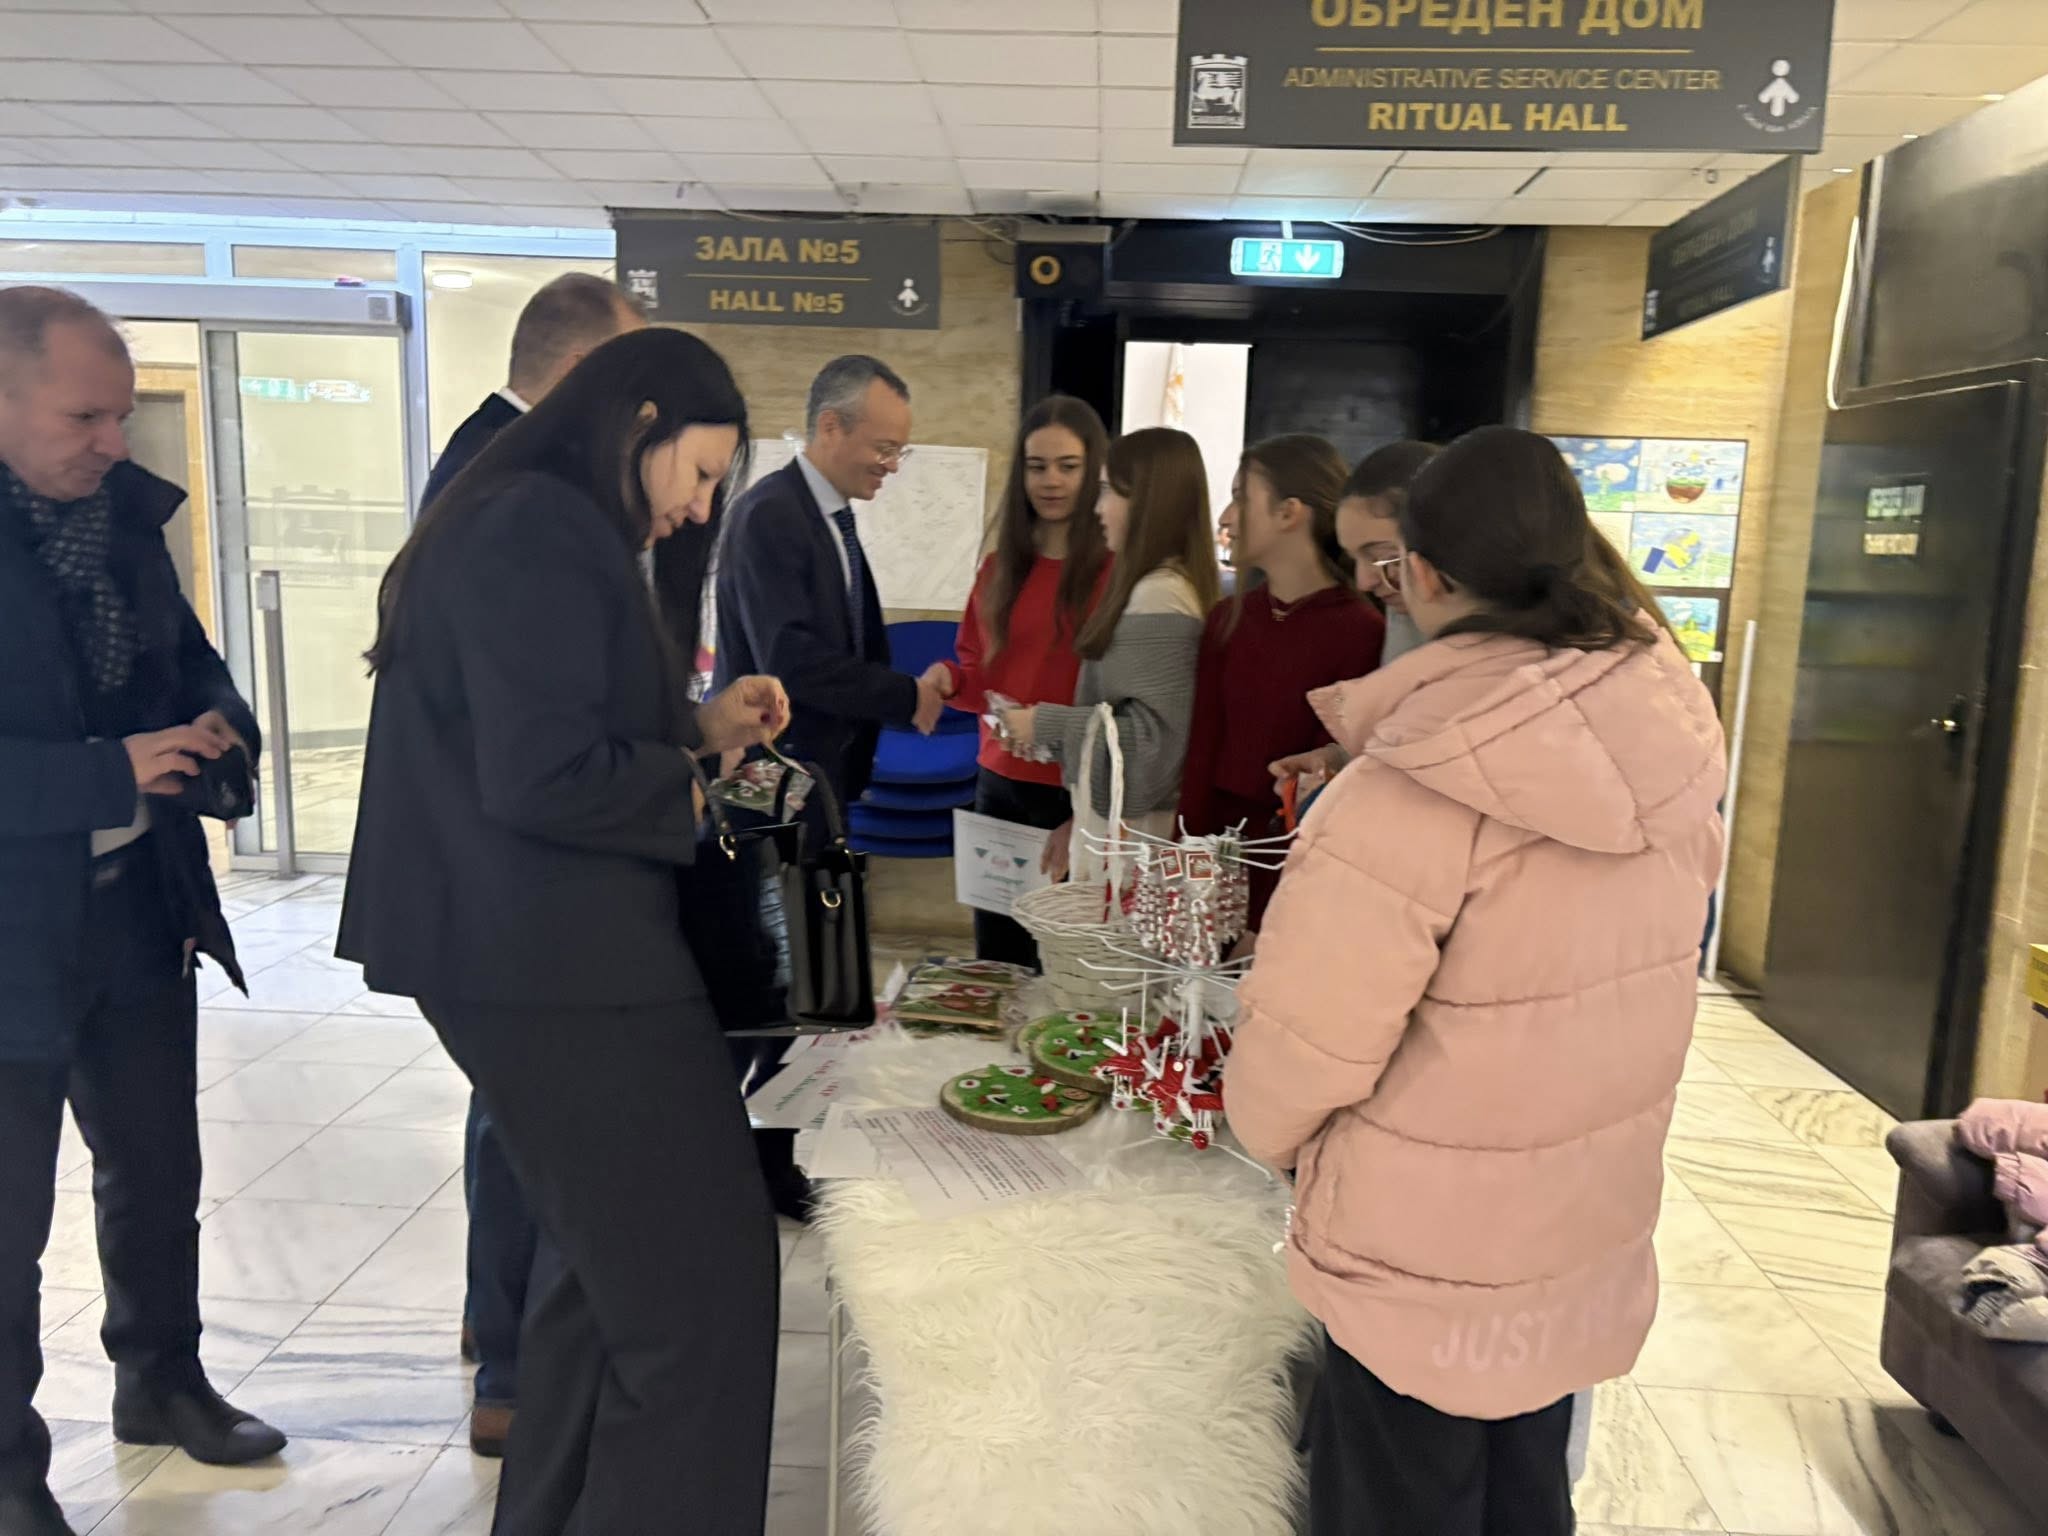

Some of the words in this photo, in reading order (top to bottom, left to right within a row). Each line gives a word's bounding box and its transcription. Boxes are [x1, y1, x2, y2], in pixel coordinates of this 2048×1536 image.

[1310, 0, 1563, 34] ОБРЕДЕН
[1577, 0, 1704, 35] ДОМ
[1284, 66, 1492, 90] ADMINISTRATIVE
[1496, 68, 1612, 91] SERVICE
[1615, 68, 1723, 92] CENTER
[1367, 102, 1516, 132] RITUAL
[1524, 103, 1630, 133] HALL
[695, 235, 789, 262] ЗАЛА
[798, 238, 861, 264] №5
[709, 289, 785, 312] HALL
[792, 291, 844, 314] №5
[1431, 1301, 1568, 1373] JUST
